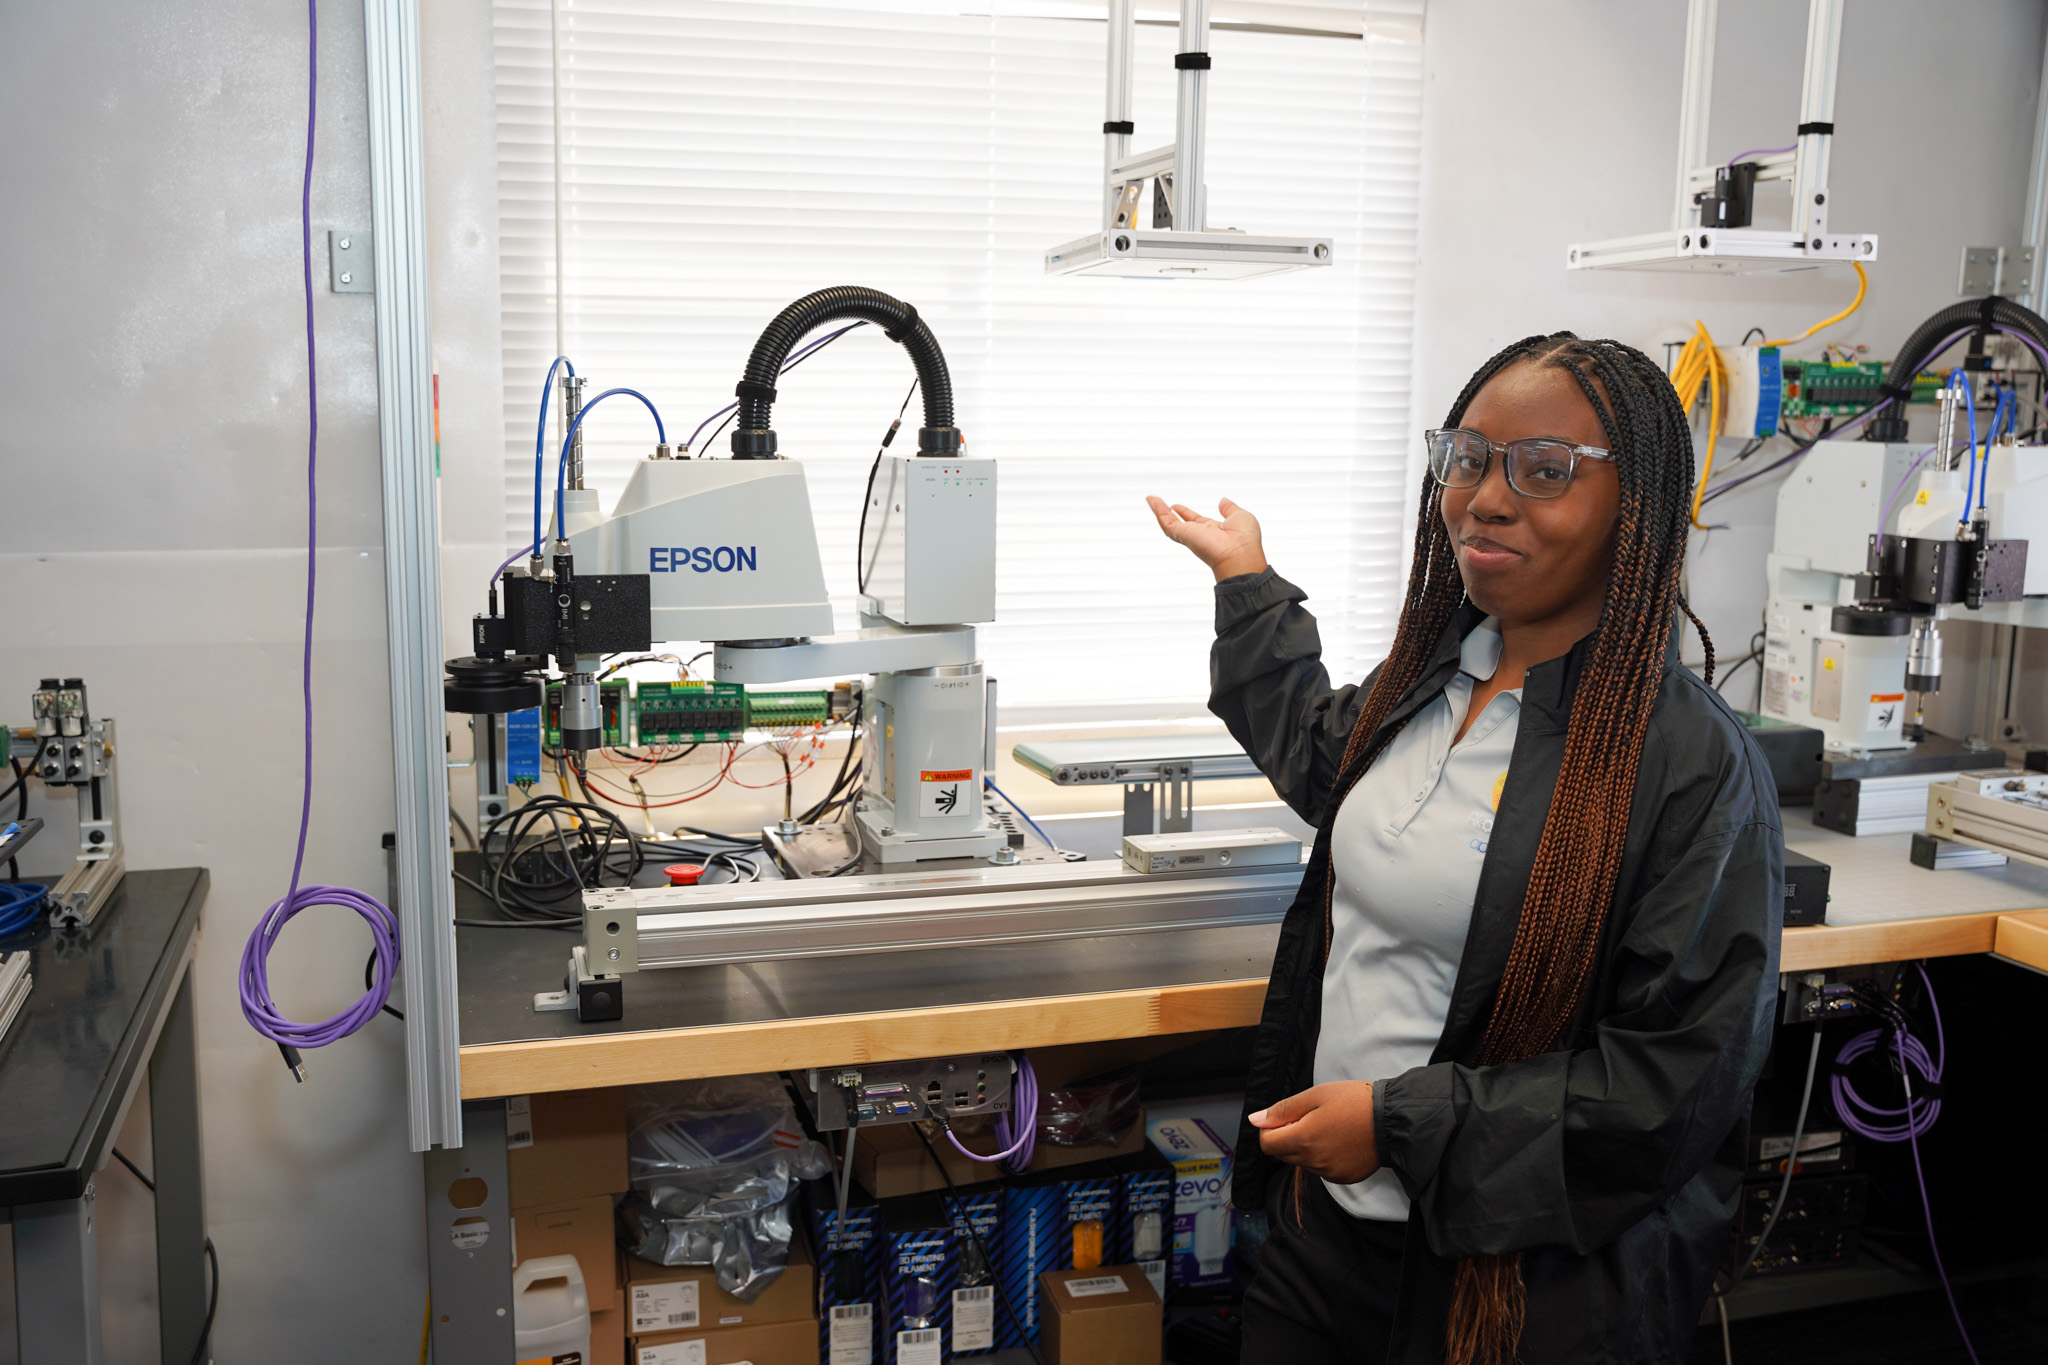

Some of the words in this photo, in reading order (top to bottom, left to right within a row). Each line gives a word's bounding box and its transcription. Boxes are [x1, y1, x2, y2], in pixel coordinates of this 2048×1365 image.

[650, 546, 756, 573] EPSON
[934, 771, 970, 780] WARNING
[981, 1055, 1008, 1064] EPSON
[993, 1102, 1007, 1110] CV1
[1199, 1163, 1220, 1171] PACK
[1080, 1202, 1111, 1212] PRINTING
[1067, 1211, 1102, 1222] FILAMENT
[903, 1240, 945, 1248] FLASHFORGE
[899, 1256, 910, 1265] 3D
[911, 1253, 945, 1264] PRINTING
[899, 1263, 936, 1274] FILAMENT
